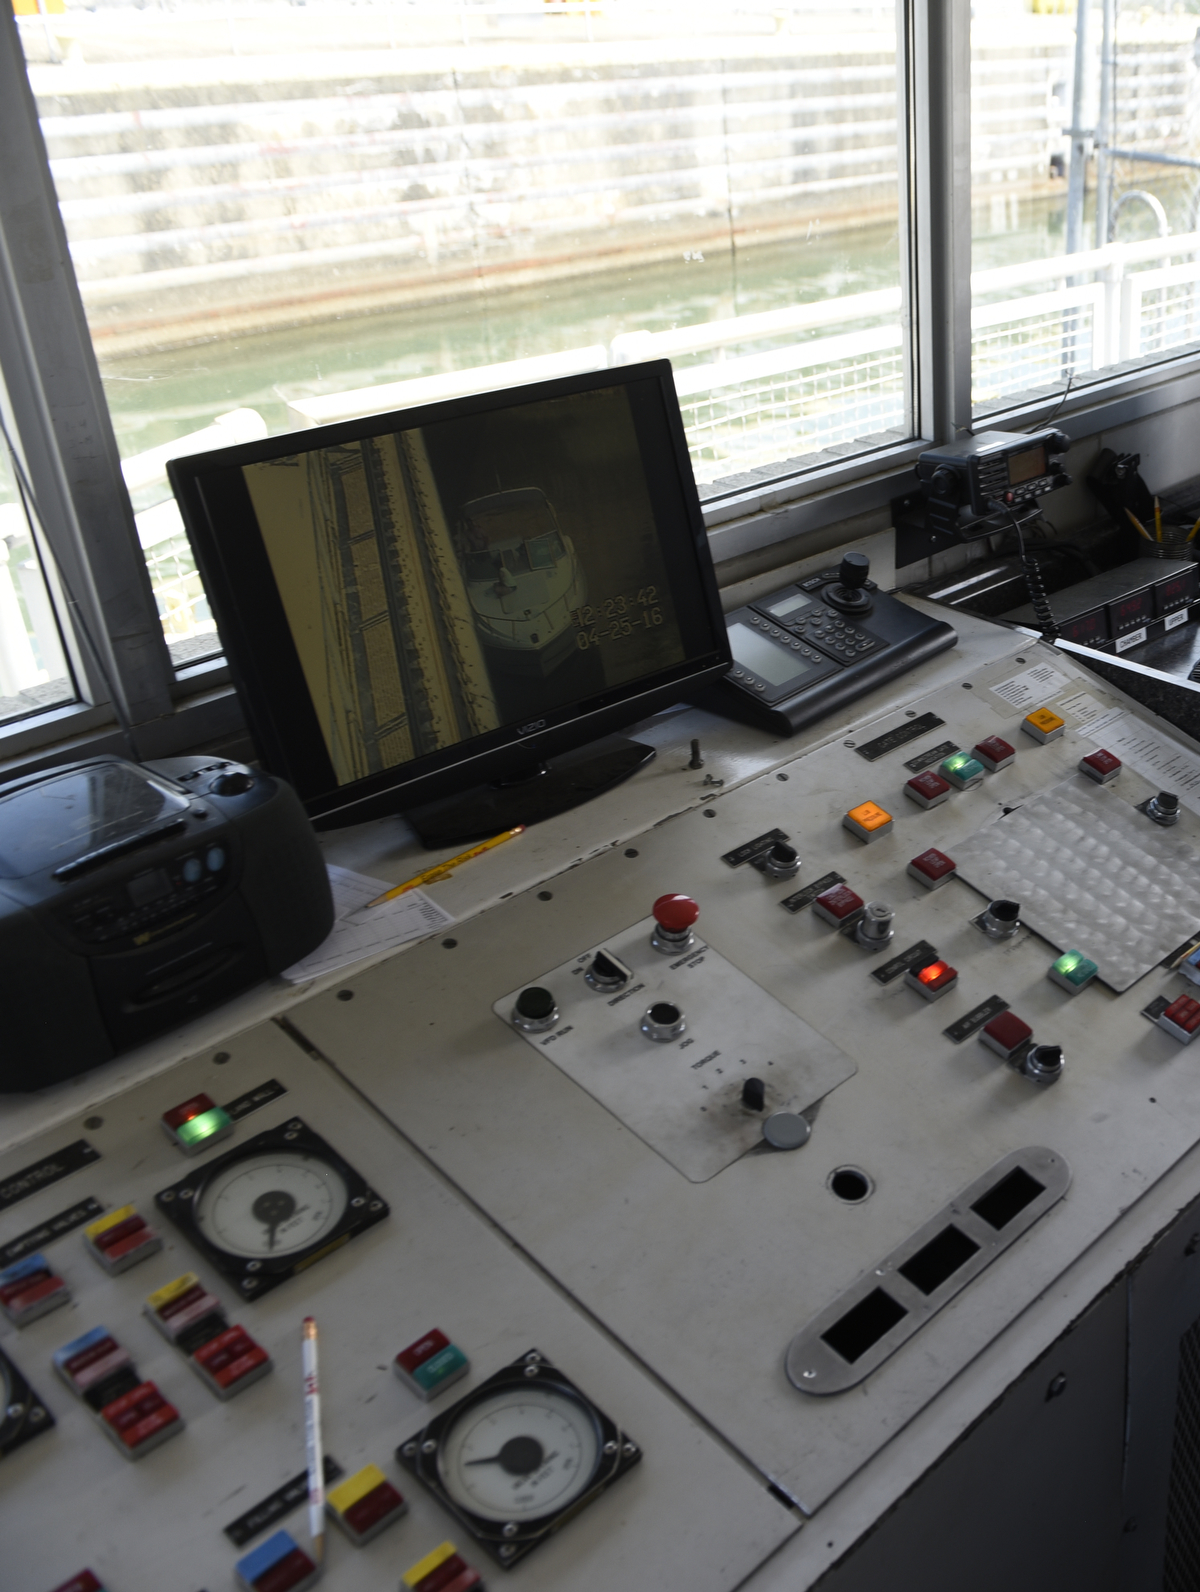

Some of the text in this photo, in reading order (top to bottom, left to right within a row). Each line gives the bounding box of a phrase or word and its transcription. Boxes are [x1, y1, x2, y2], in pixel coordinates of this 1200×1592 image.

[574, 584, 659, 630] 12:23:42
[575, 606, 665, 650] 04-25-16
[1167, 612, 1185, 627] UPPER
[1119, 632, 1144, 650] CHAMBER
[515, 718, 547, 736] VIZIO
[895, 723, 927, 740] CONTROL
[576, 953, 592, 965] OFF
[669, 945, 710, 970] EMERGENCY
[686, 955, 706, 969] STOP
[570, 966, 585, 977] ON
[606, 983, 646, 1006] DIRECTION
[539, 1024, 575, 1046] VFD RUN
[678, 1037, 696, 1050] JOG
[690, 1049, 723, 1071] TORQUE
[1, 1162, 65, 1200] CONTROL
[427, 1350, 456, 1374] CLOSED
